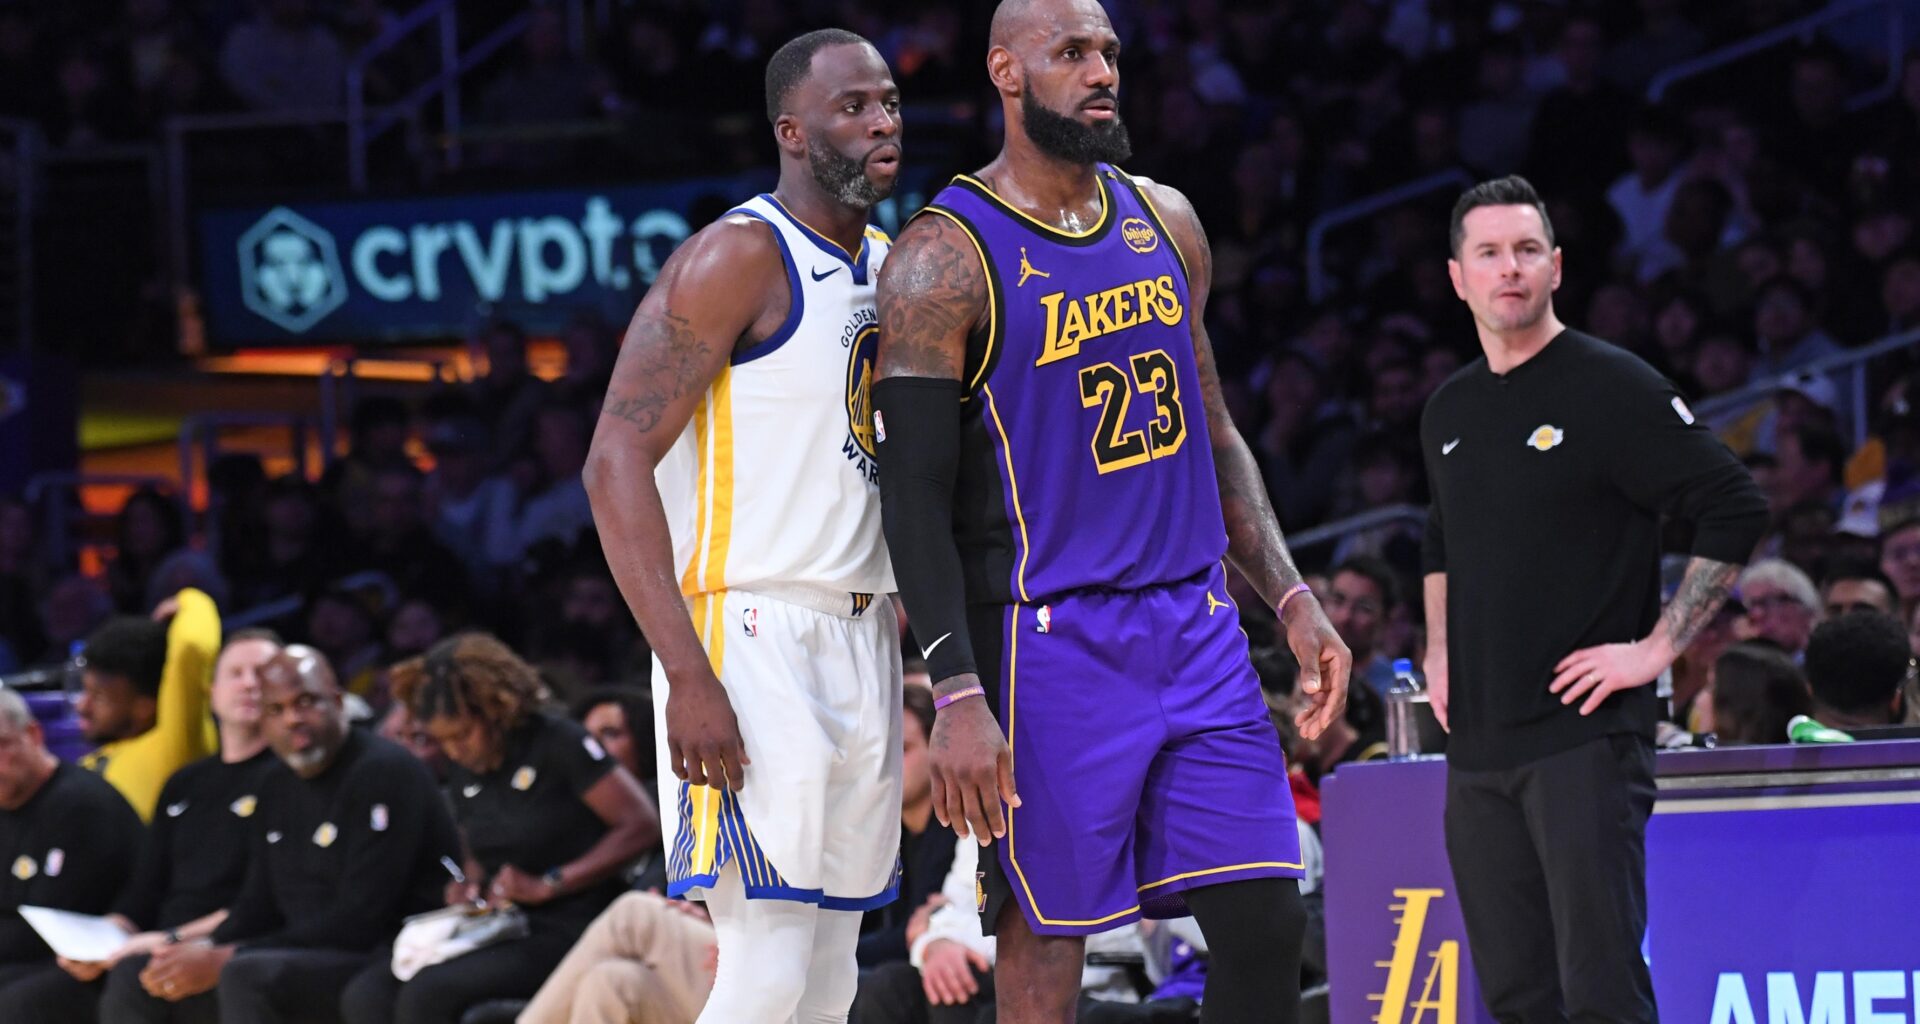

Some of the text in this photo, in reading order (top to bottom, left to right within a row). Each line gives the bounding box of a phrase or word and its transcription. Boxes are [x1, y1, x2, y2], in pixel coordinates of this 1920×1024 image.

[841, 308, 877, 348] GOLDEN
[1035, 275, 1184, 367] LAKERS
[1078, 349, 1187, 475] 23
[1709, 970, 1920, 1024] AME
